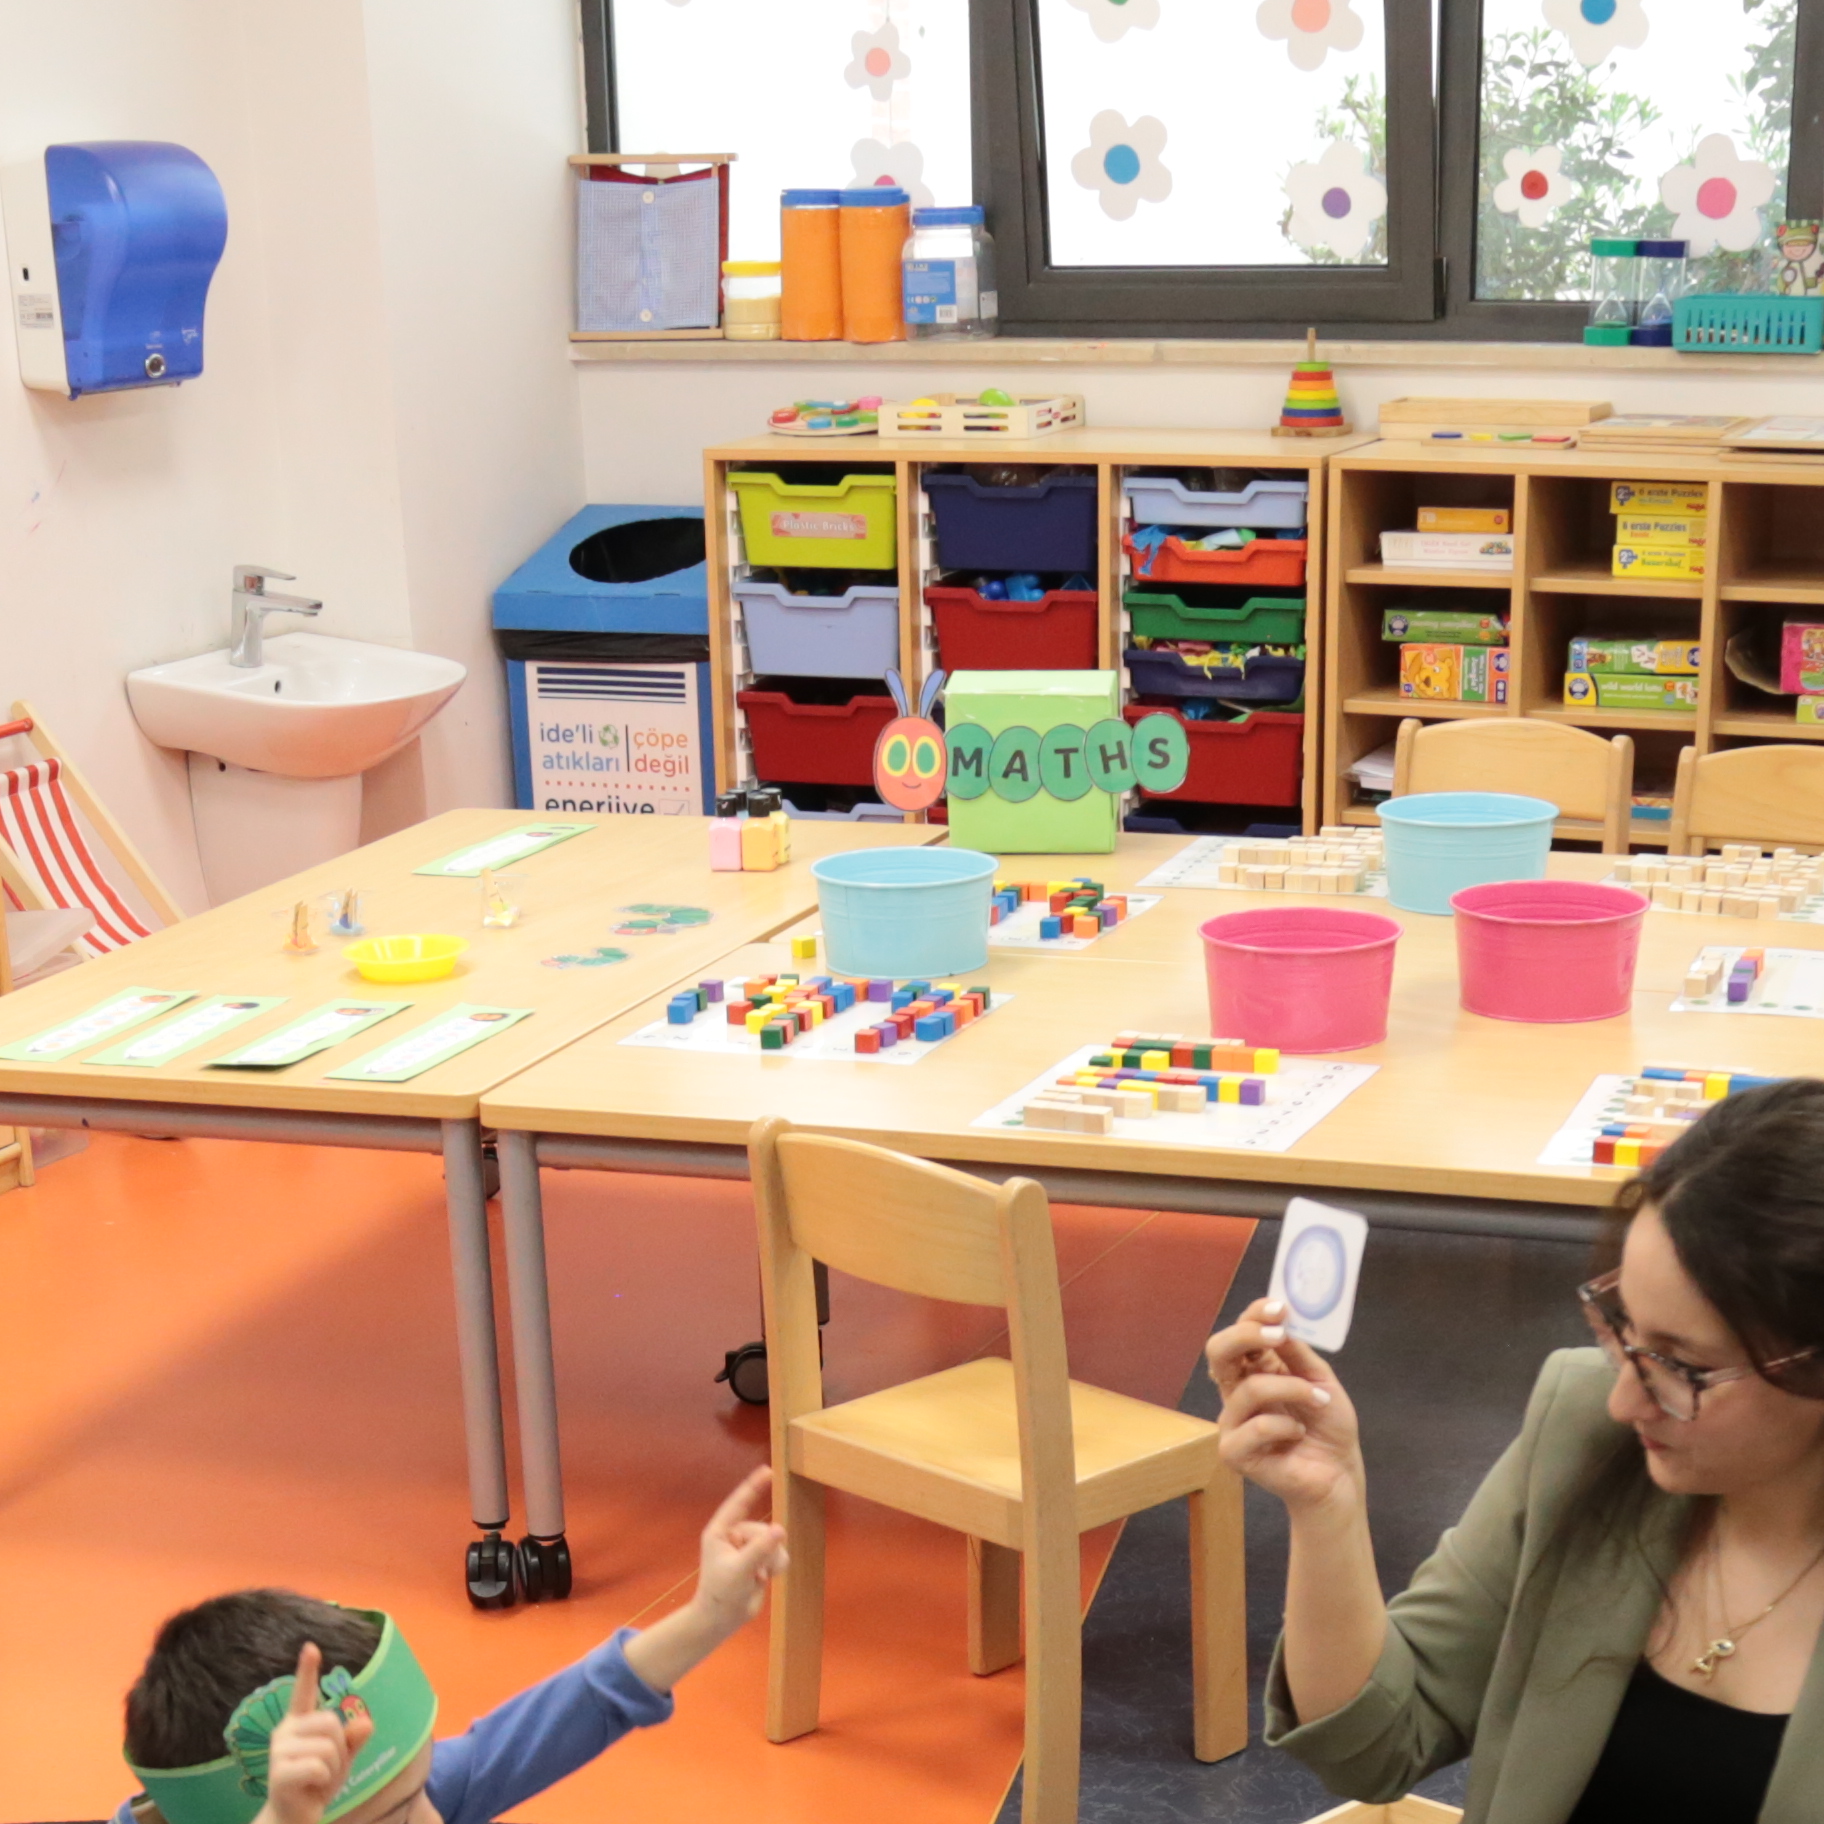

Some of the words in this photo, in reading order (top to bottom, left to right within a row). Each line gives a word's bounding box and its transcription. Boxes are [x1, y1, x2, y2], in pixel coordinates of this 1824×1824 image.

[783, 519, 818, 530] Plastic
[822, 520, 855, 531] Bricks
[540, 722, 595, 744] ide'li
[633, 727, 689, 750] çöpe
[542, 751, 620, 773] atıkları
[634, 753, 690, 777] değil
[951, 736, 1172, 783] MATHS
